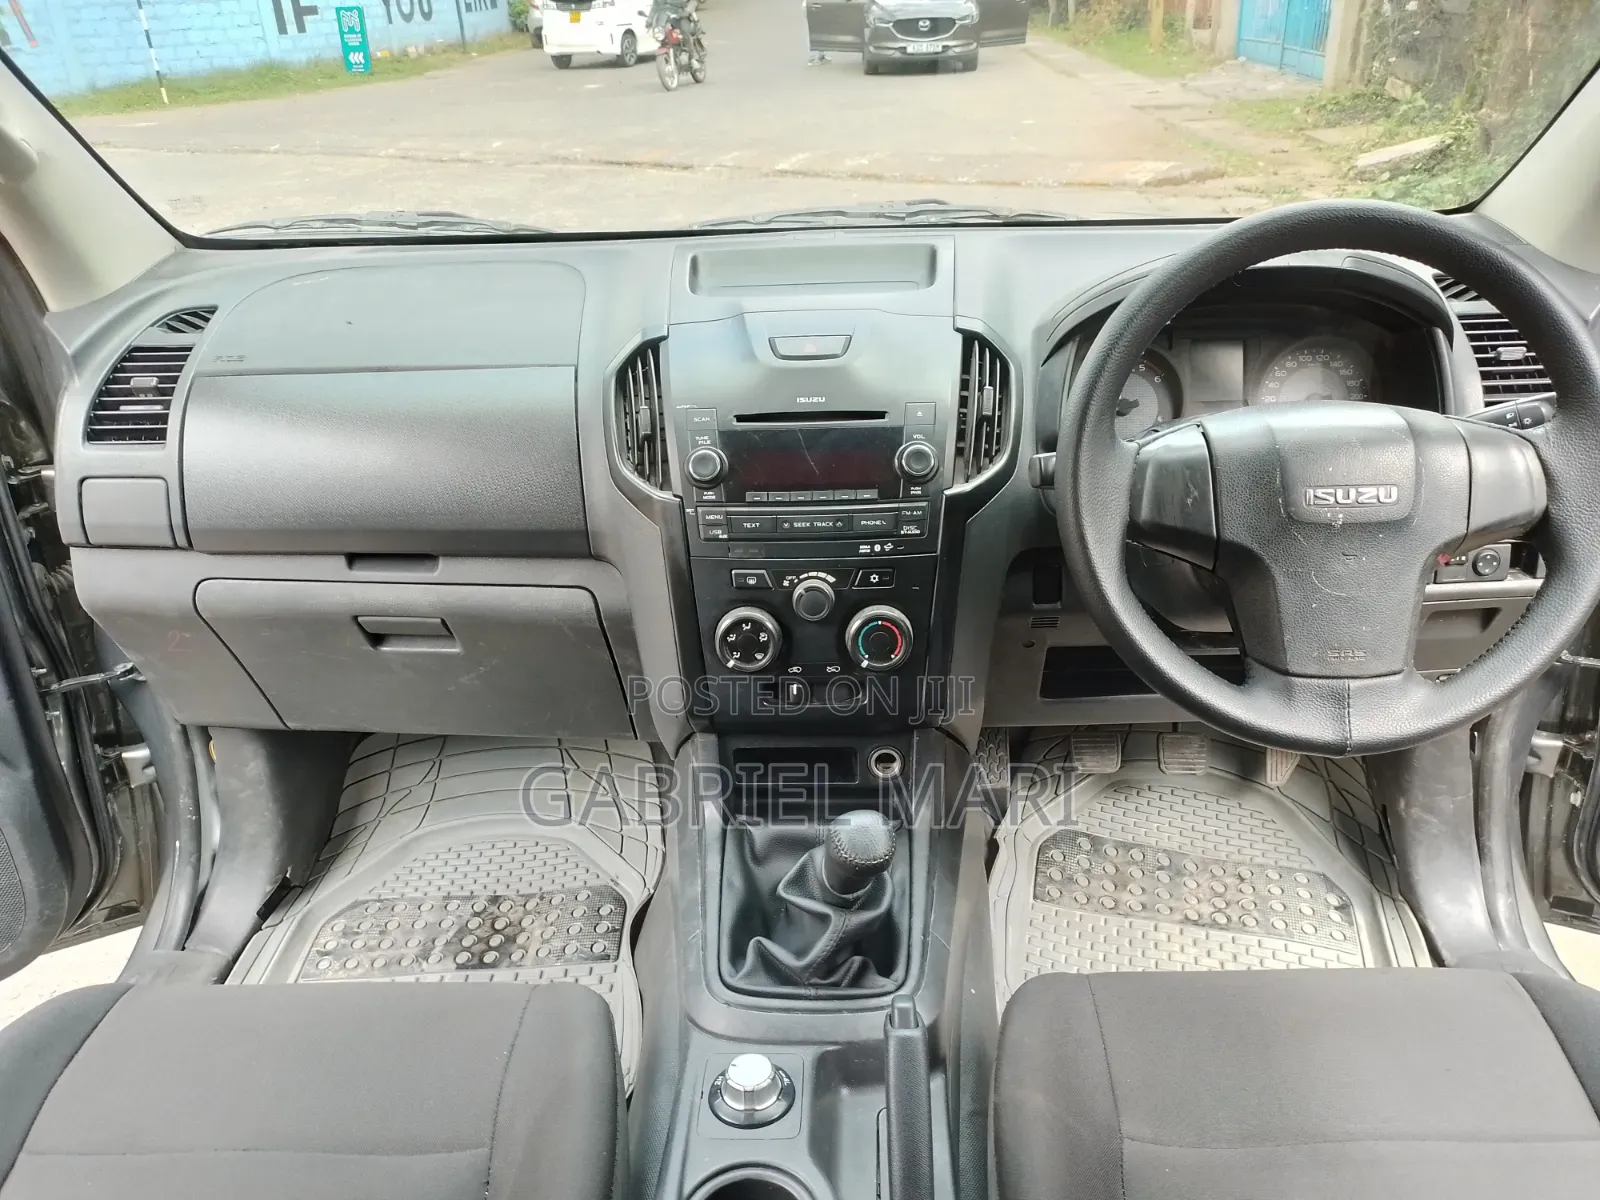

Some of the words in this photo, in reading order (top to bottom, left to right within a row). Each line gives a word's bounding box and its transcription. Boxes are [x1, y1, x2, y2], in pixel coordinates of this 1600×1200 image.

[271, 0, 319, 35] IF
[1139, 364, 1146, 372] 5
[1305, 485, 1398, 506] ISUZU
